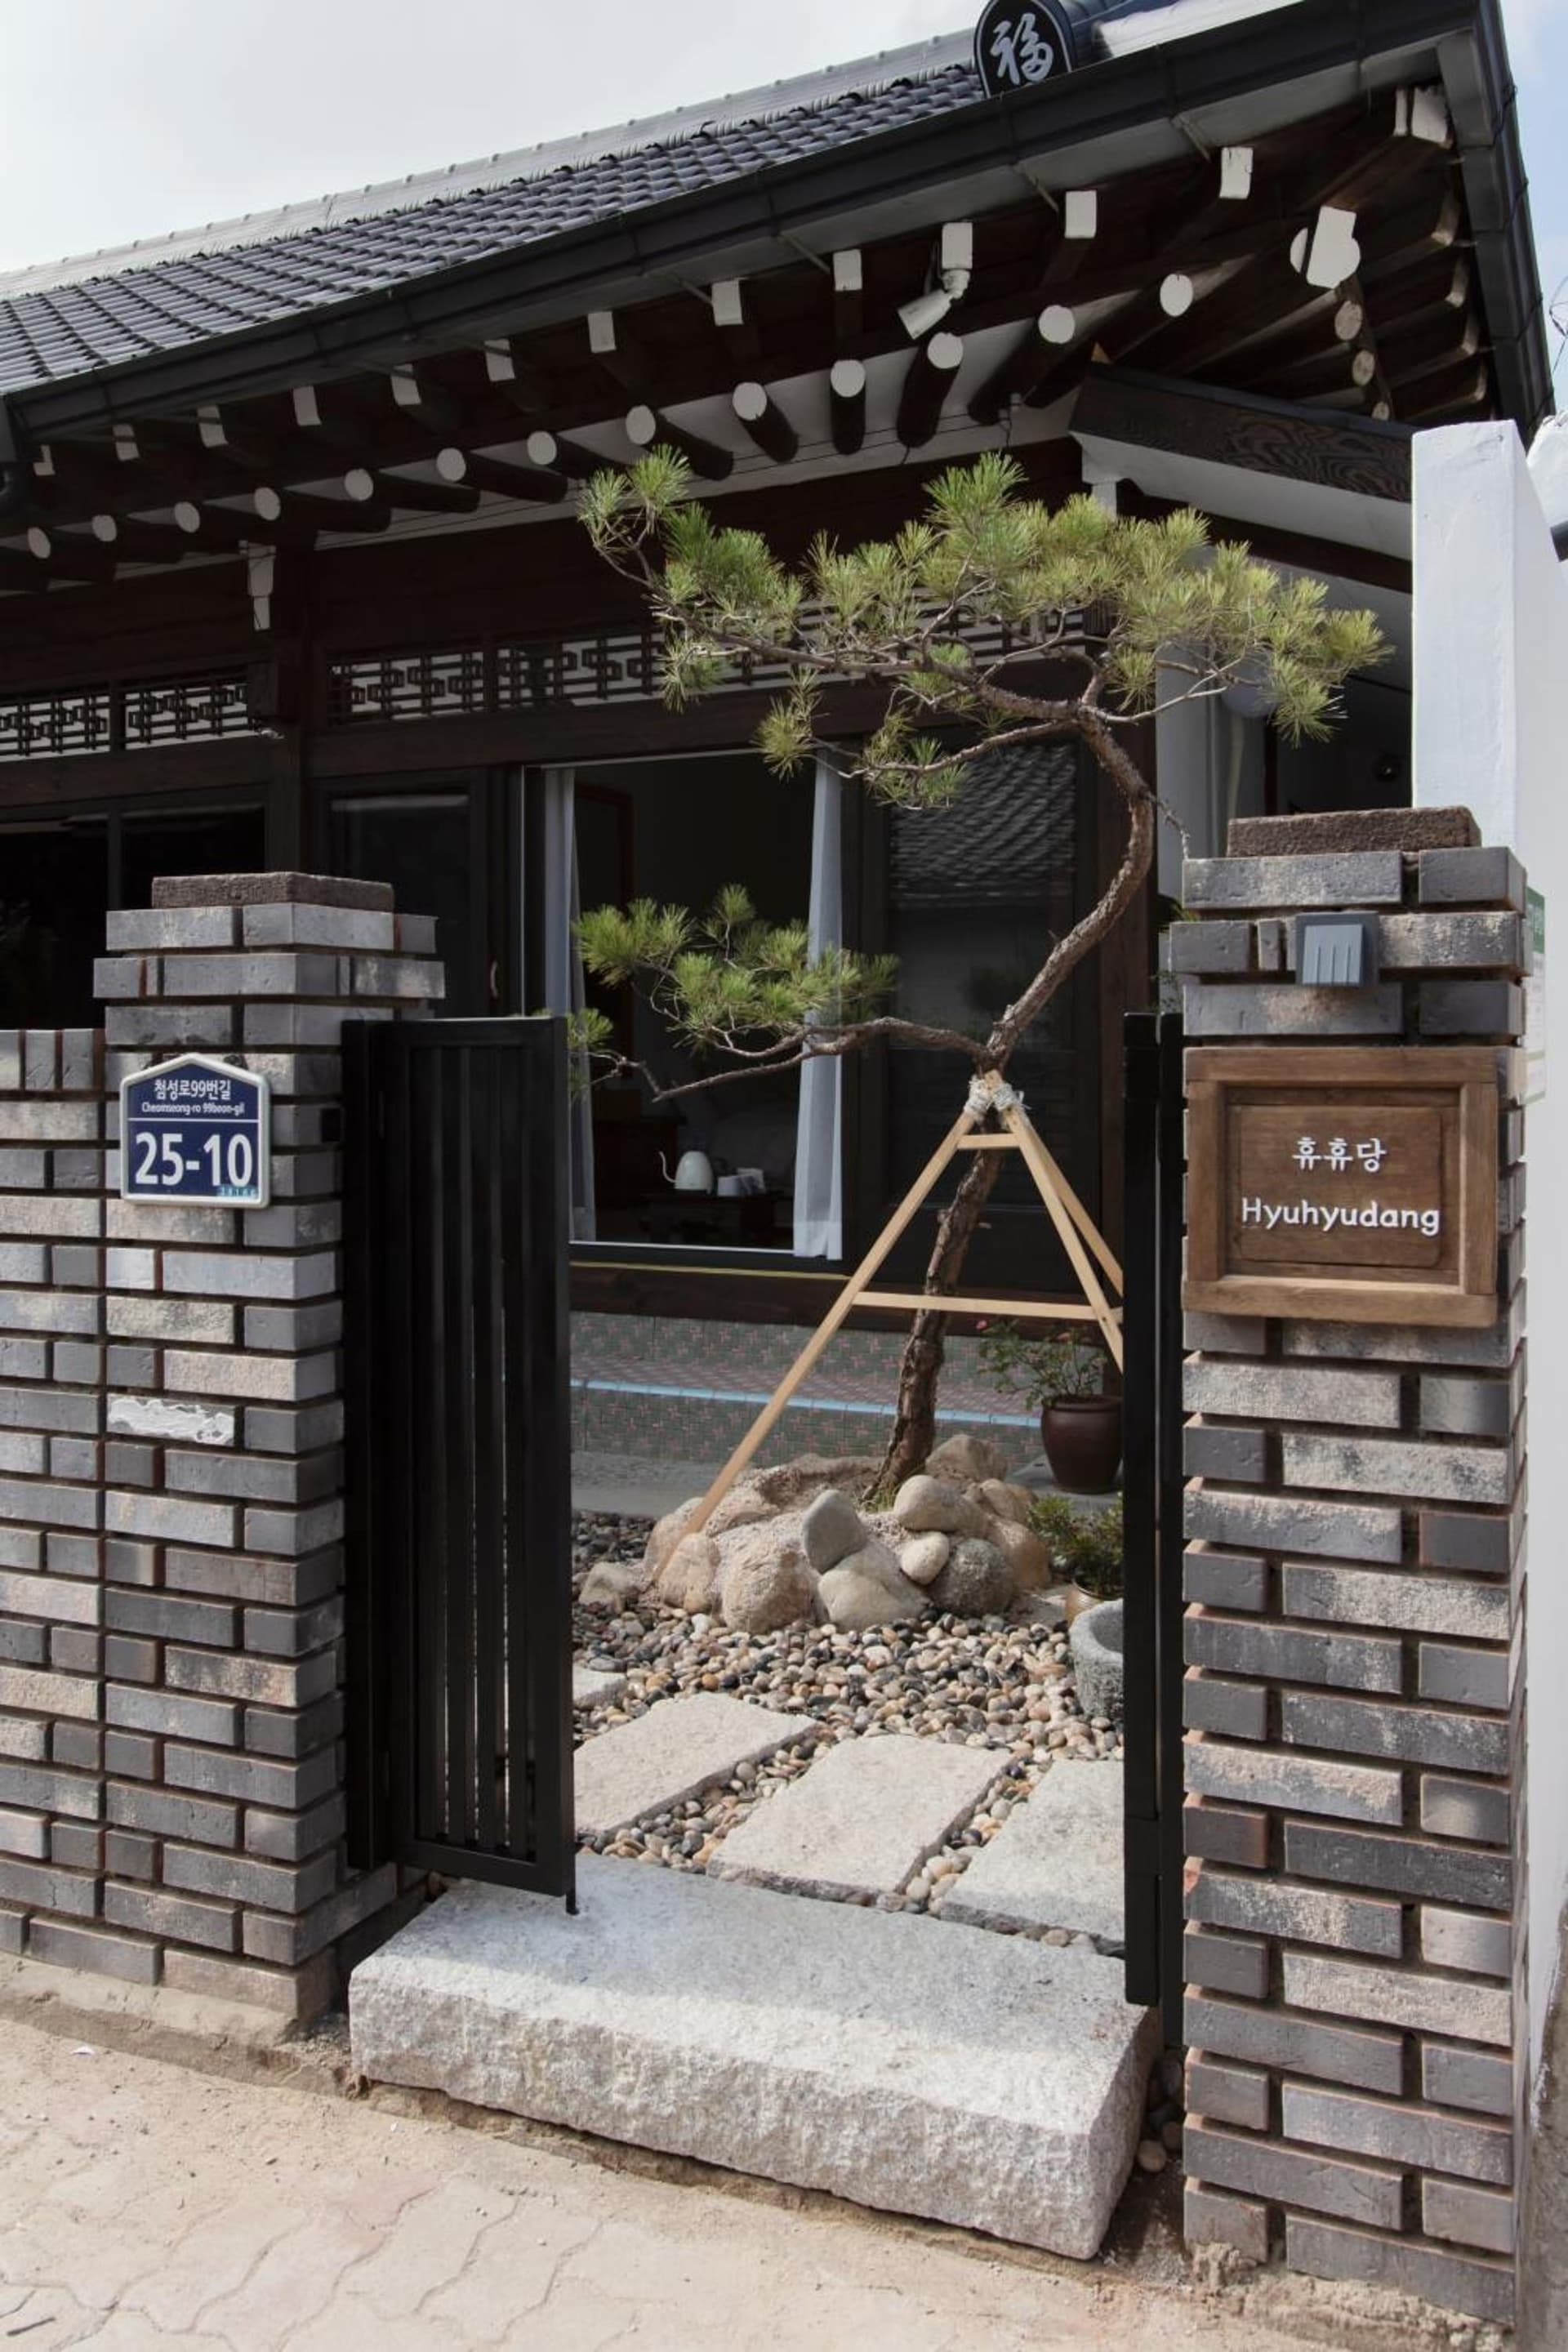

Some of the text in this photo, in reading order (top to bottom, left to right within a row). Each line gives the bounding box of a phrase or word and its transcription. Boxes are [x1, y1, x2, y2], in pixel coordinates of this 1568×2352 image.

[990, 12, 1054, 83] 福
[154, 1078, 232, 1101] 첨성로99번길
[135, 1131, 253, 1187] 25-10
[1292, 1136, 1387, 1173] 휴휴당
[1241, 1196, 1440, 1236] Hyuhyudang
